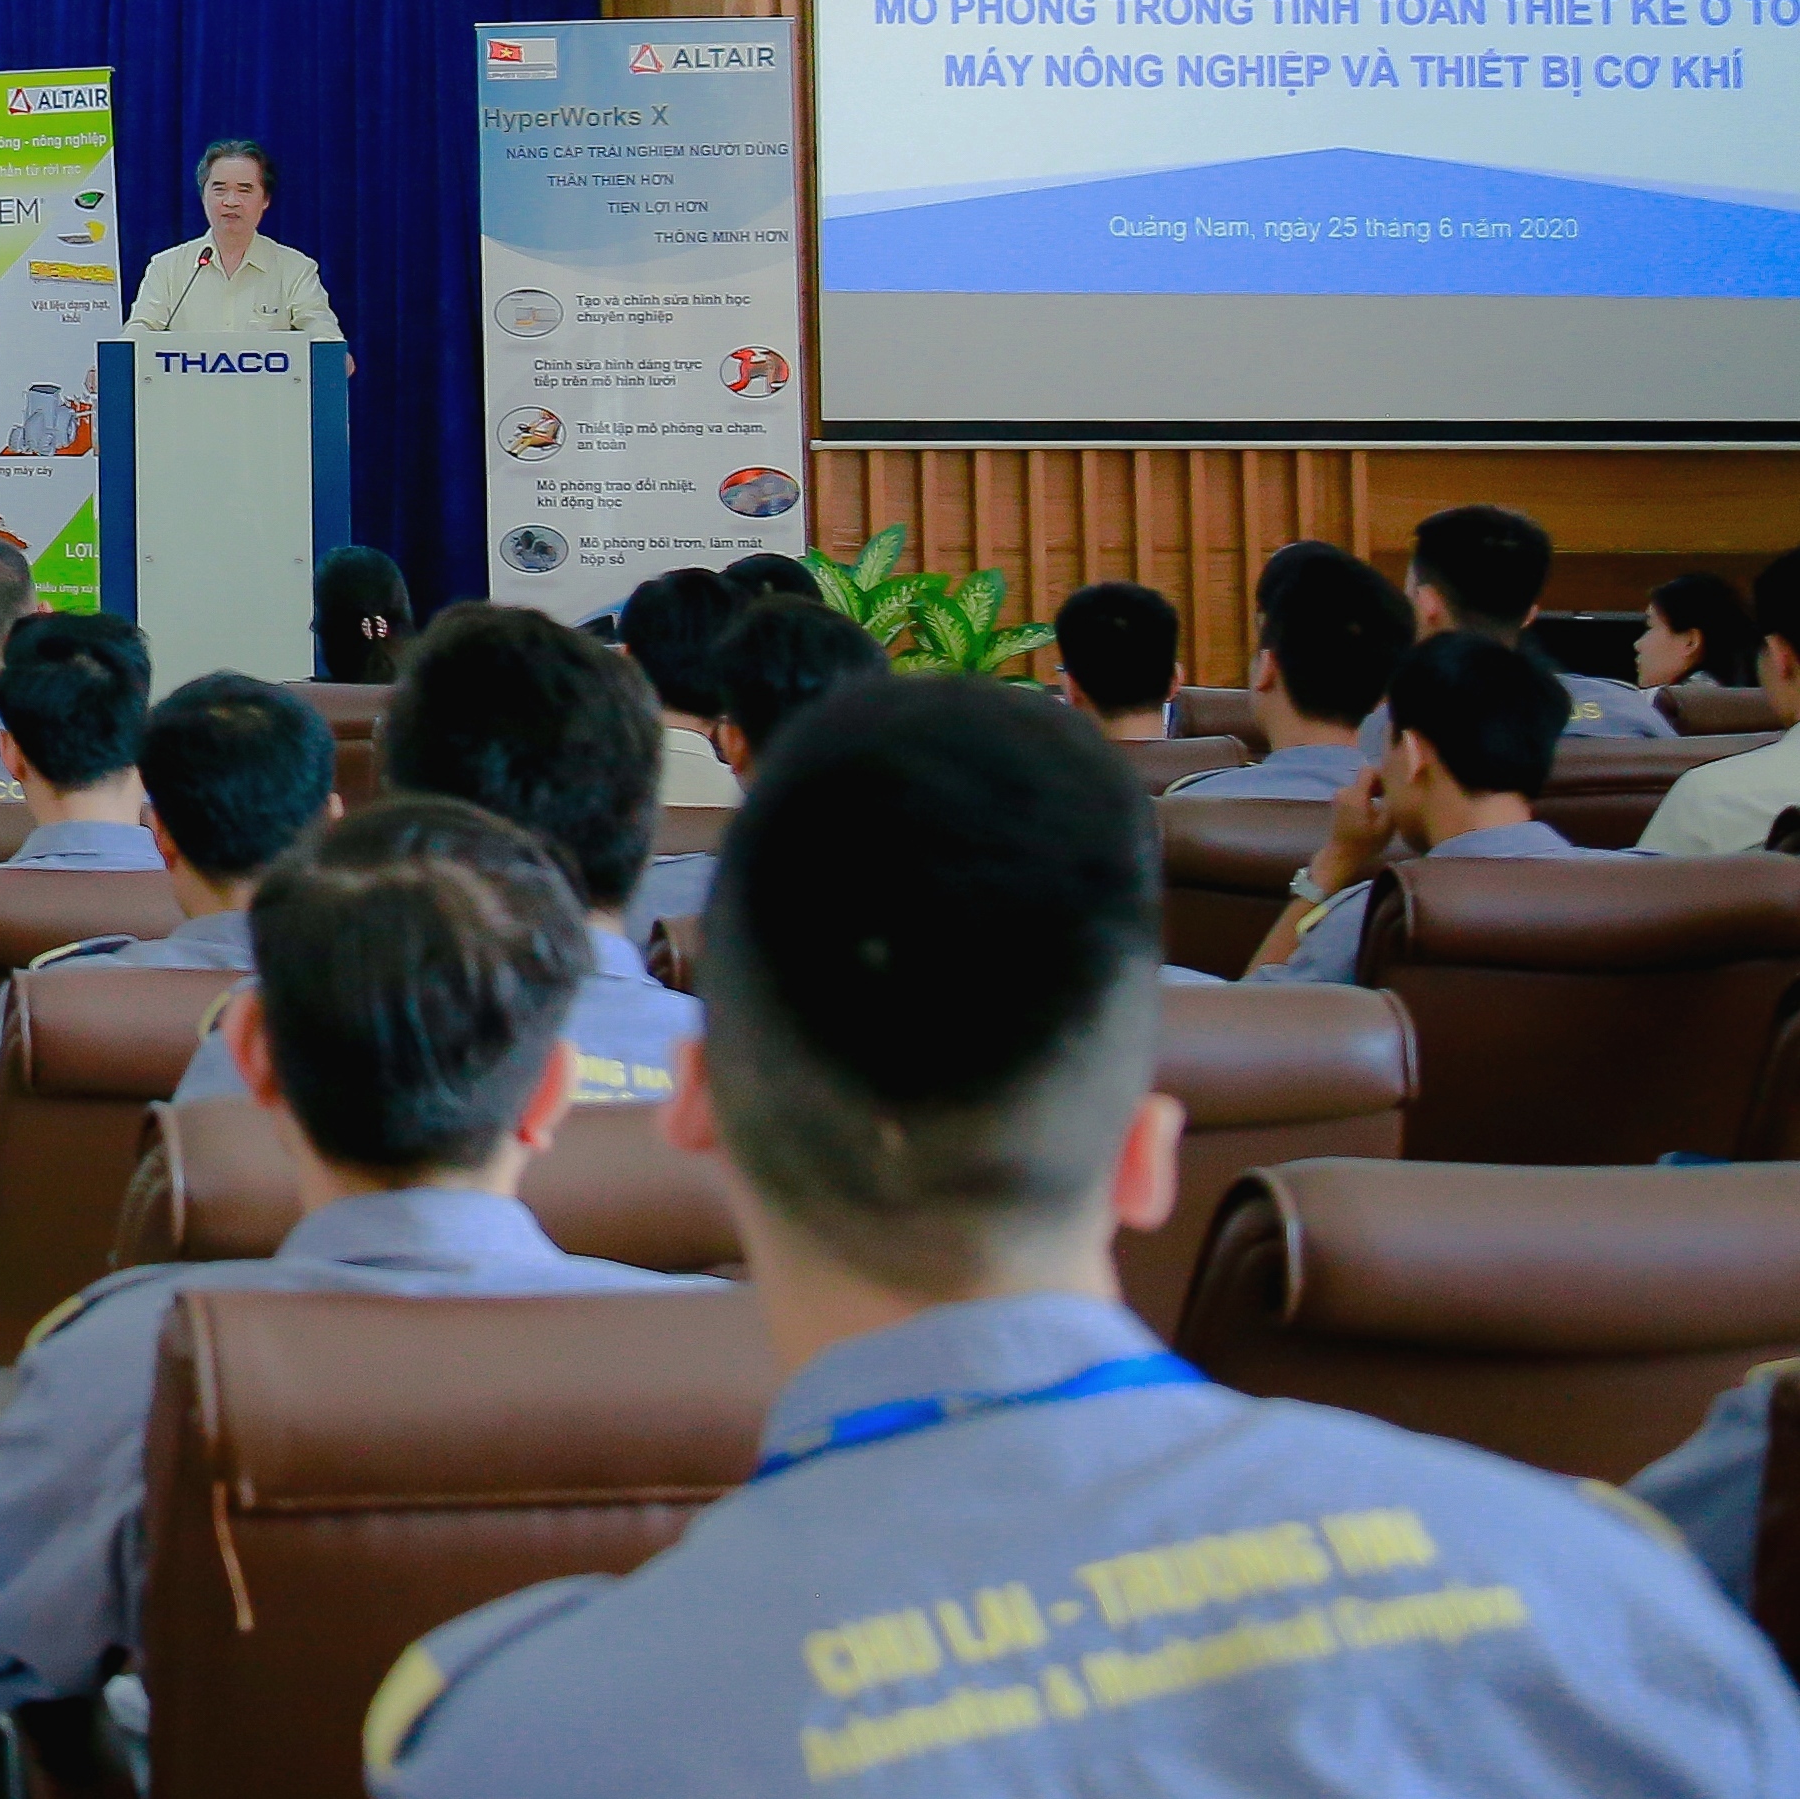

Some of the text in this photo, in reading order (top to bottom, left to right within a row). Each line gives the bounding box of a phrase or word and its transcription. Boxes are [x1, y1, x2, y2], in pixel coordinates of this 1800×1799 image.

[673, 48, 775, 68] ALTAIR
[945, 45, 1743, 97] MÁY NÔNG NGHIỆP VÀ THIẾT BỊ CƠ KHÍ
[38, 89, 107, 109] ALTAIR
[484, 105, 669, 133] HyperWorks X
[712, 232, 750, 243] MINH
[1110, 213, 1578, 242] Quảng Nam, ngày 25 tháng 6 năm 2020
[155, 352, 289, 374] THACO
